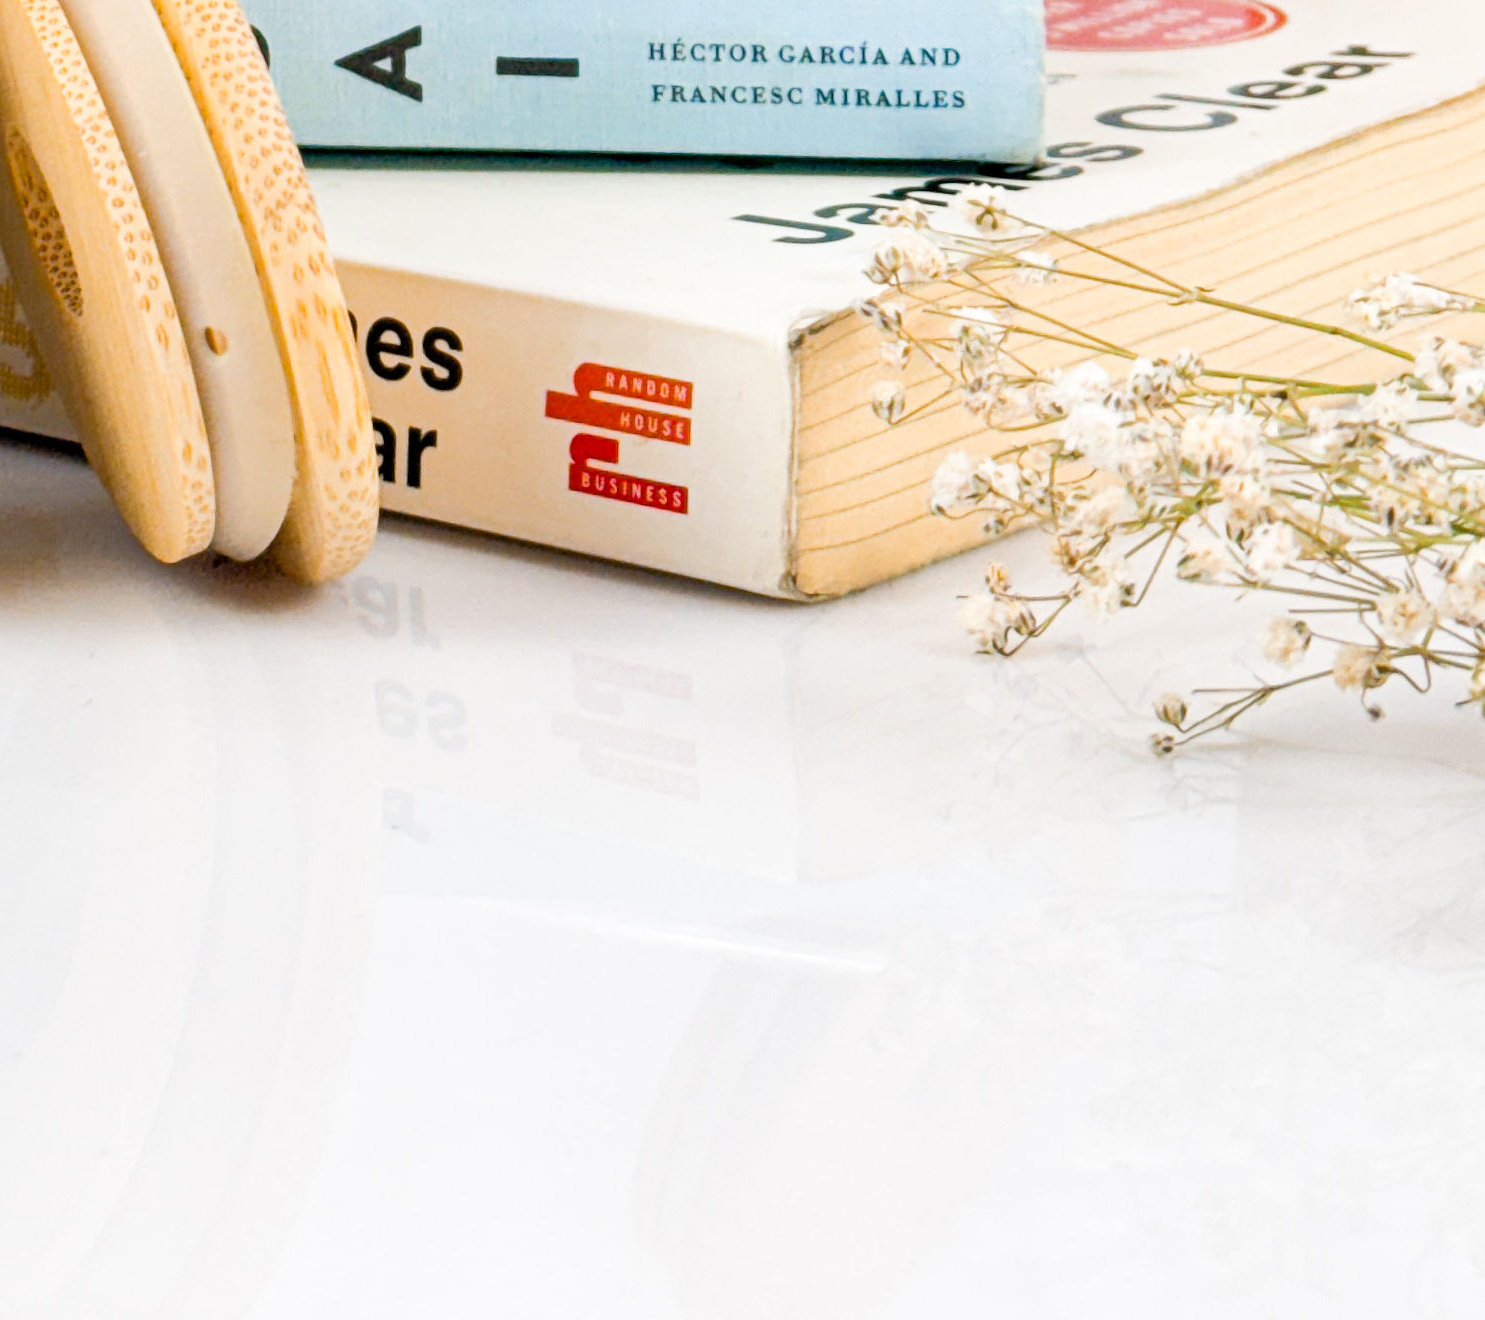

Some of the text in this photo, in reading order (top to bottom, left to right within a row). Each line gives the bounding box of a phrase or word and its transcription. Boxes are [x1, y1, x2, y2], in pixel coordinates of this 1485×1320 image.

[647, 37, 962, 67] HÉCTOR GARCÍA AND
[651, 83, 965, 109] FRANCESC MIRALLES
[1095, 42, 1417, 134] Clear
[605, 370, 687, 402] RANDOM
[619, 411, 684, 439] HOUSE
[581, 471, 682, 508] BUSINESS
